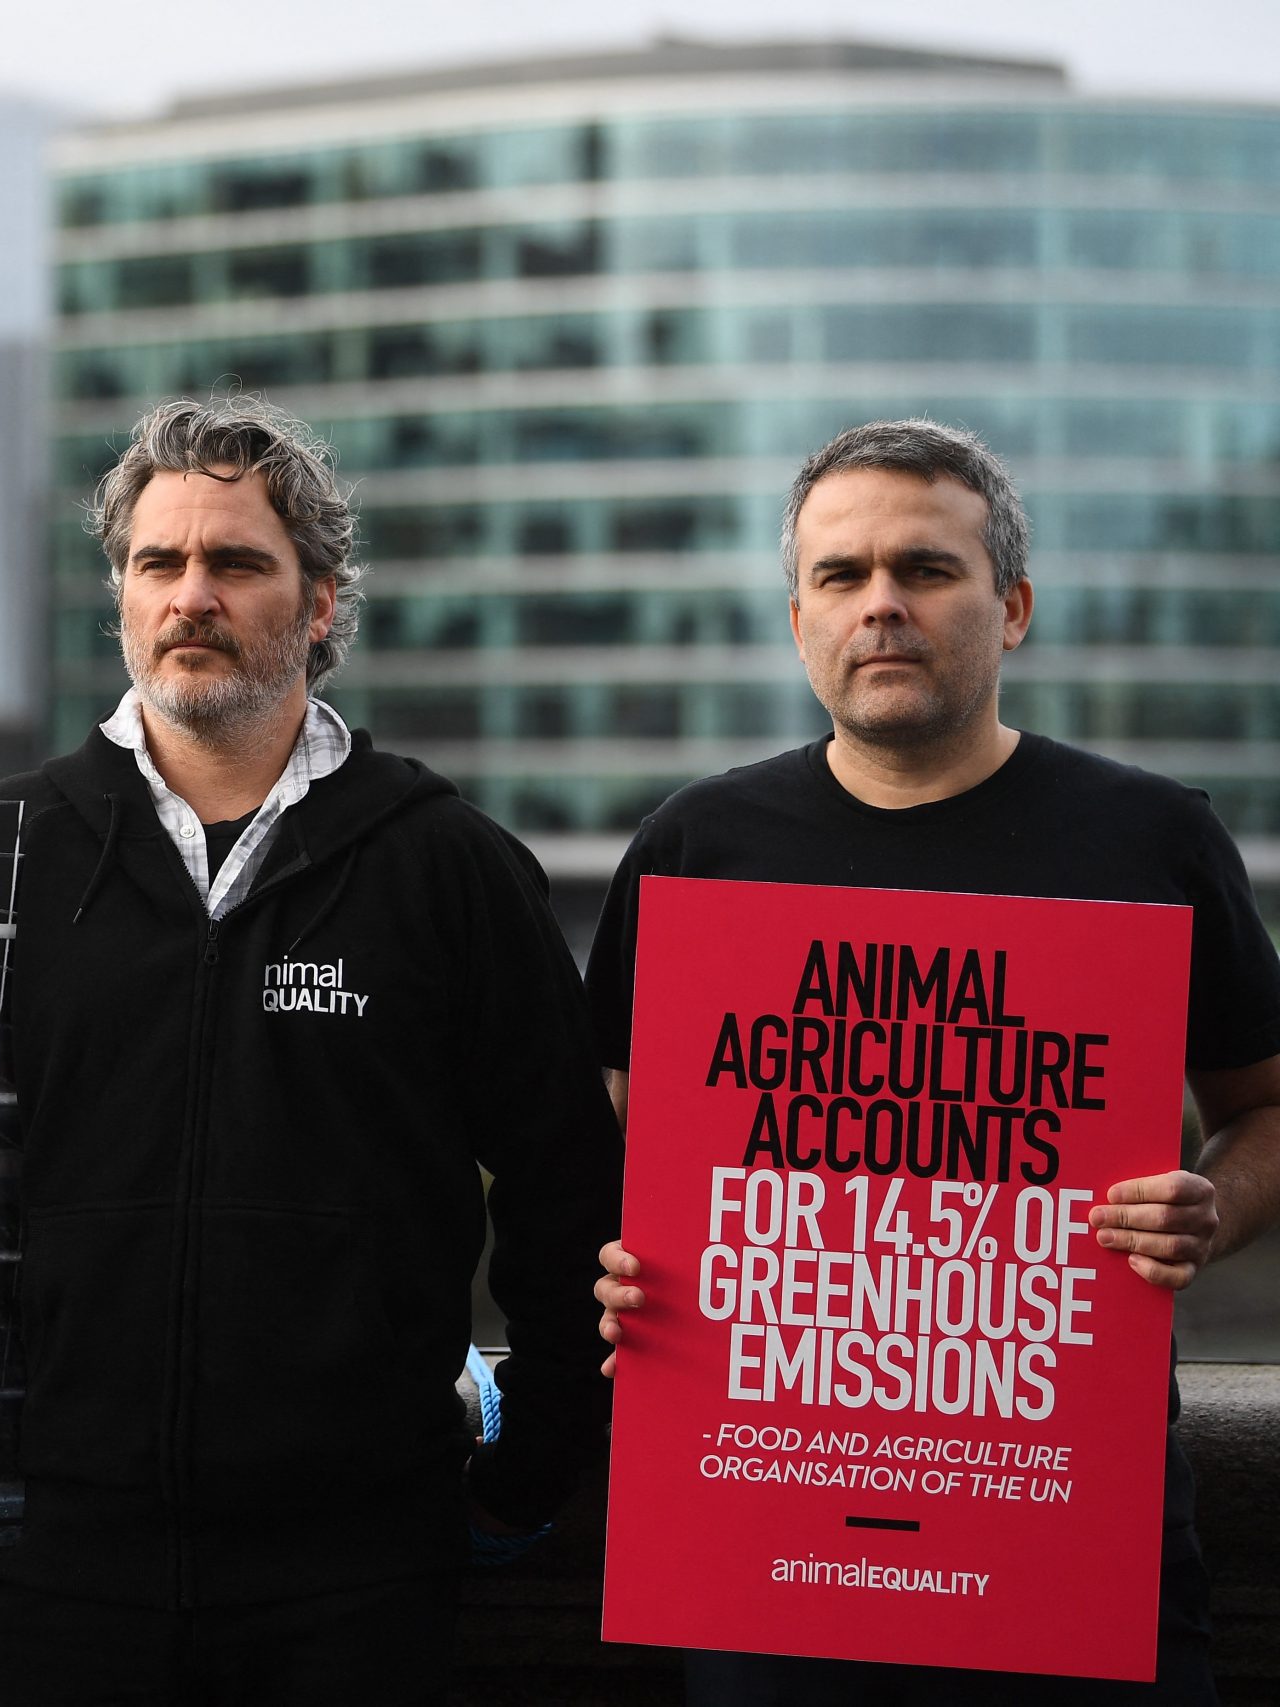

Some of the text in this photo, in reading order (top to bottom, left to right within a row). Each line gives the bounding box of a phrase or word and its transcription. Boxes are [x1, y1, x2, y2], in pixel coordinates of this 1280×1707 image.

[262, 987, 369, 1017] QUALITY
[264, 955, 343, 988] nimal
[792, 939, 1025, 1028] ANIMAL
[705, 1012, 1109, 1111] AGRICULTURE
[742, 1092, 1061, 1185] ACCOUNTS
[708, 1166, 1094, 1265] FOR 14.5% OF
[698, 1243, 1096, 1346] GREENHOUSE
[728, 1323, 1057, 1421] EMISSIONS
[699, 1454, 1072, 1504] ORGANISATION OF THE UN
[716, 1423, 802, 1452] FOOD
[805, 1430, 869, 1456] AND
[872, 1435, 1072, 1471] AGRICULTURE
[771, 1553, 990, 1596] animalEQUALITY
